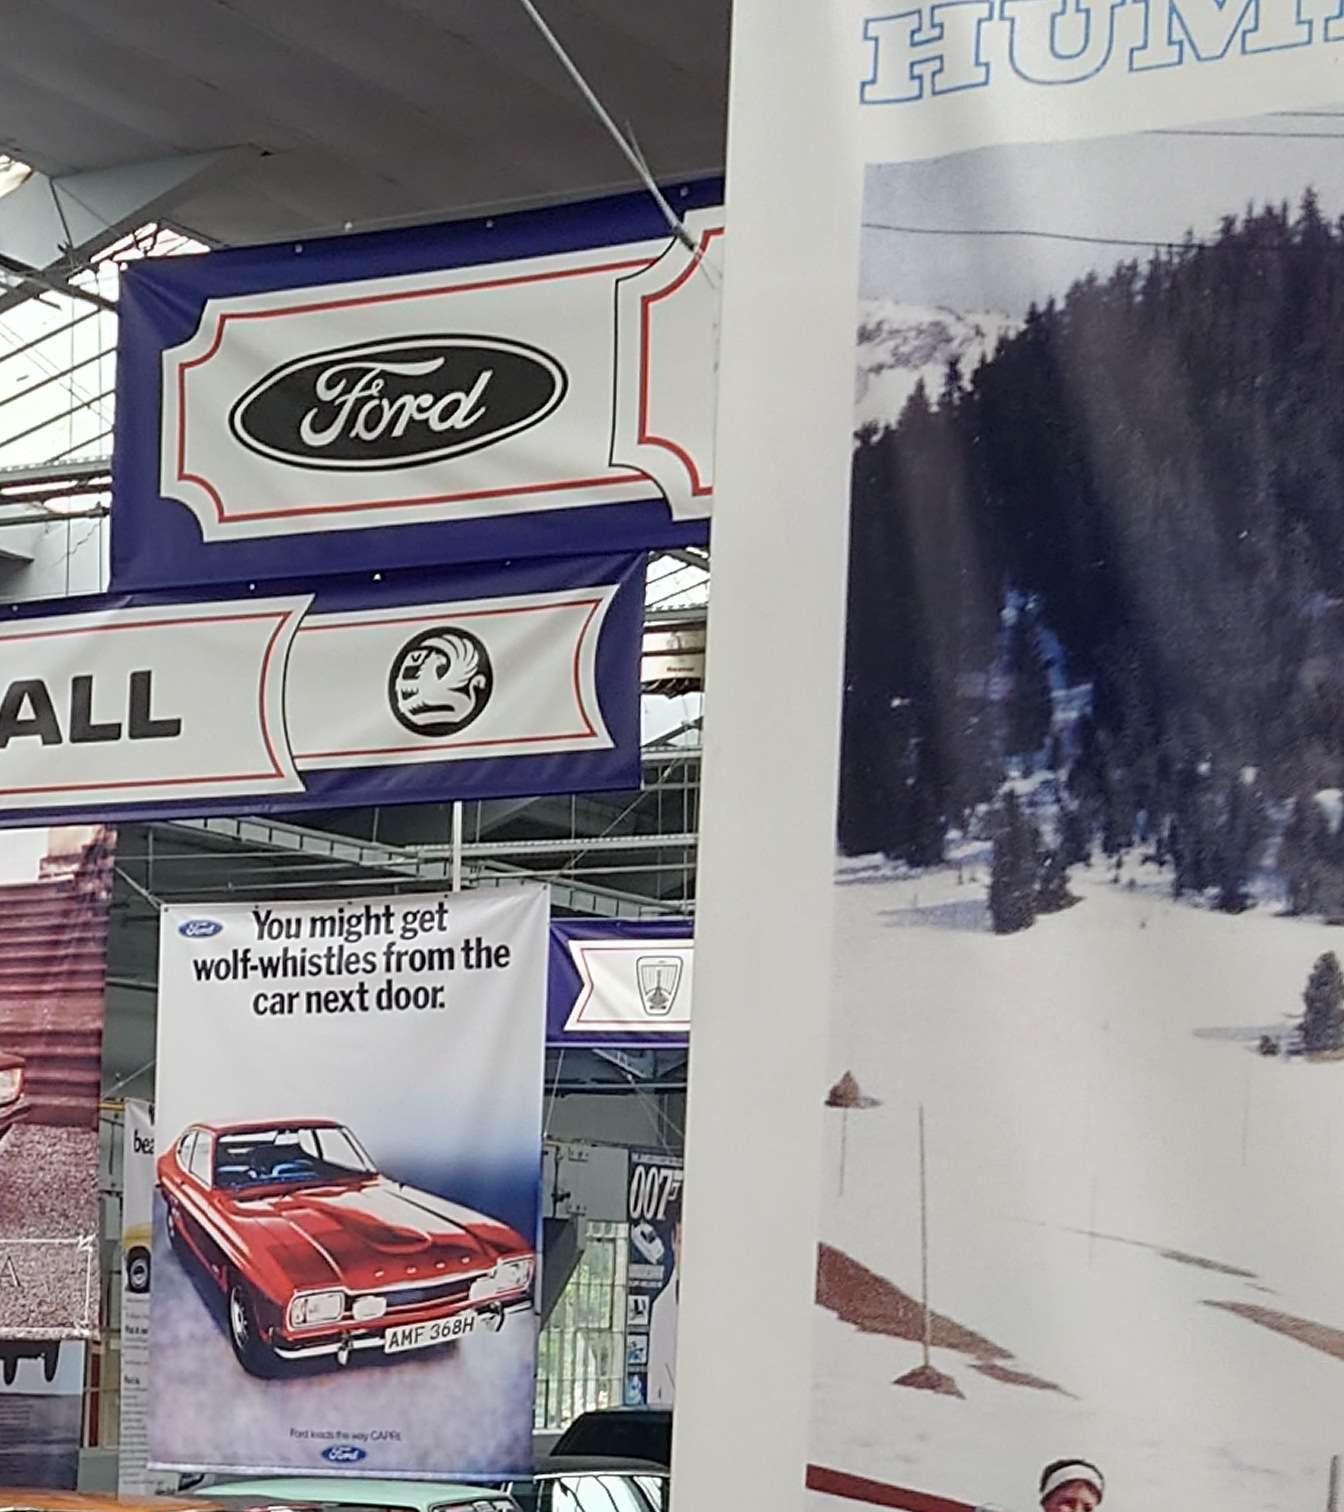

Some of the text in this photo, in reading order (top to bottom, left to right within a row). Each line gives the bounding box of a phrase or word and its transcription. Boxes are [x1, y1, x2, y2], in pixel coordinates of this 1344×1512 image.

[860, 0, 1344, 104] HUM
[300, 355, 494, 447] Ford
[252, 902, 449, 943] You might get
[192, 937, 511, 982] wolf-whistles from the
[252, 980, 446, 1016] car next door.
[630, 1165, 673, 1220] 007
[388, 1316, 475, 1348] AMF 368H
